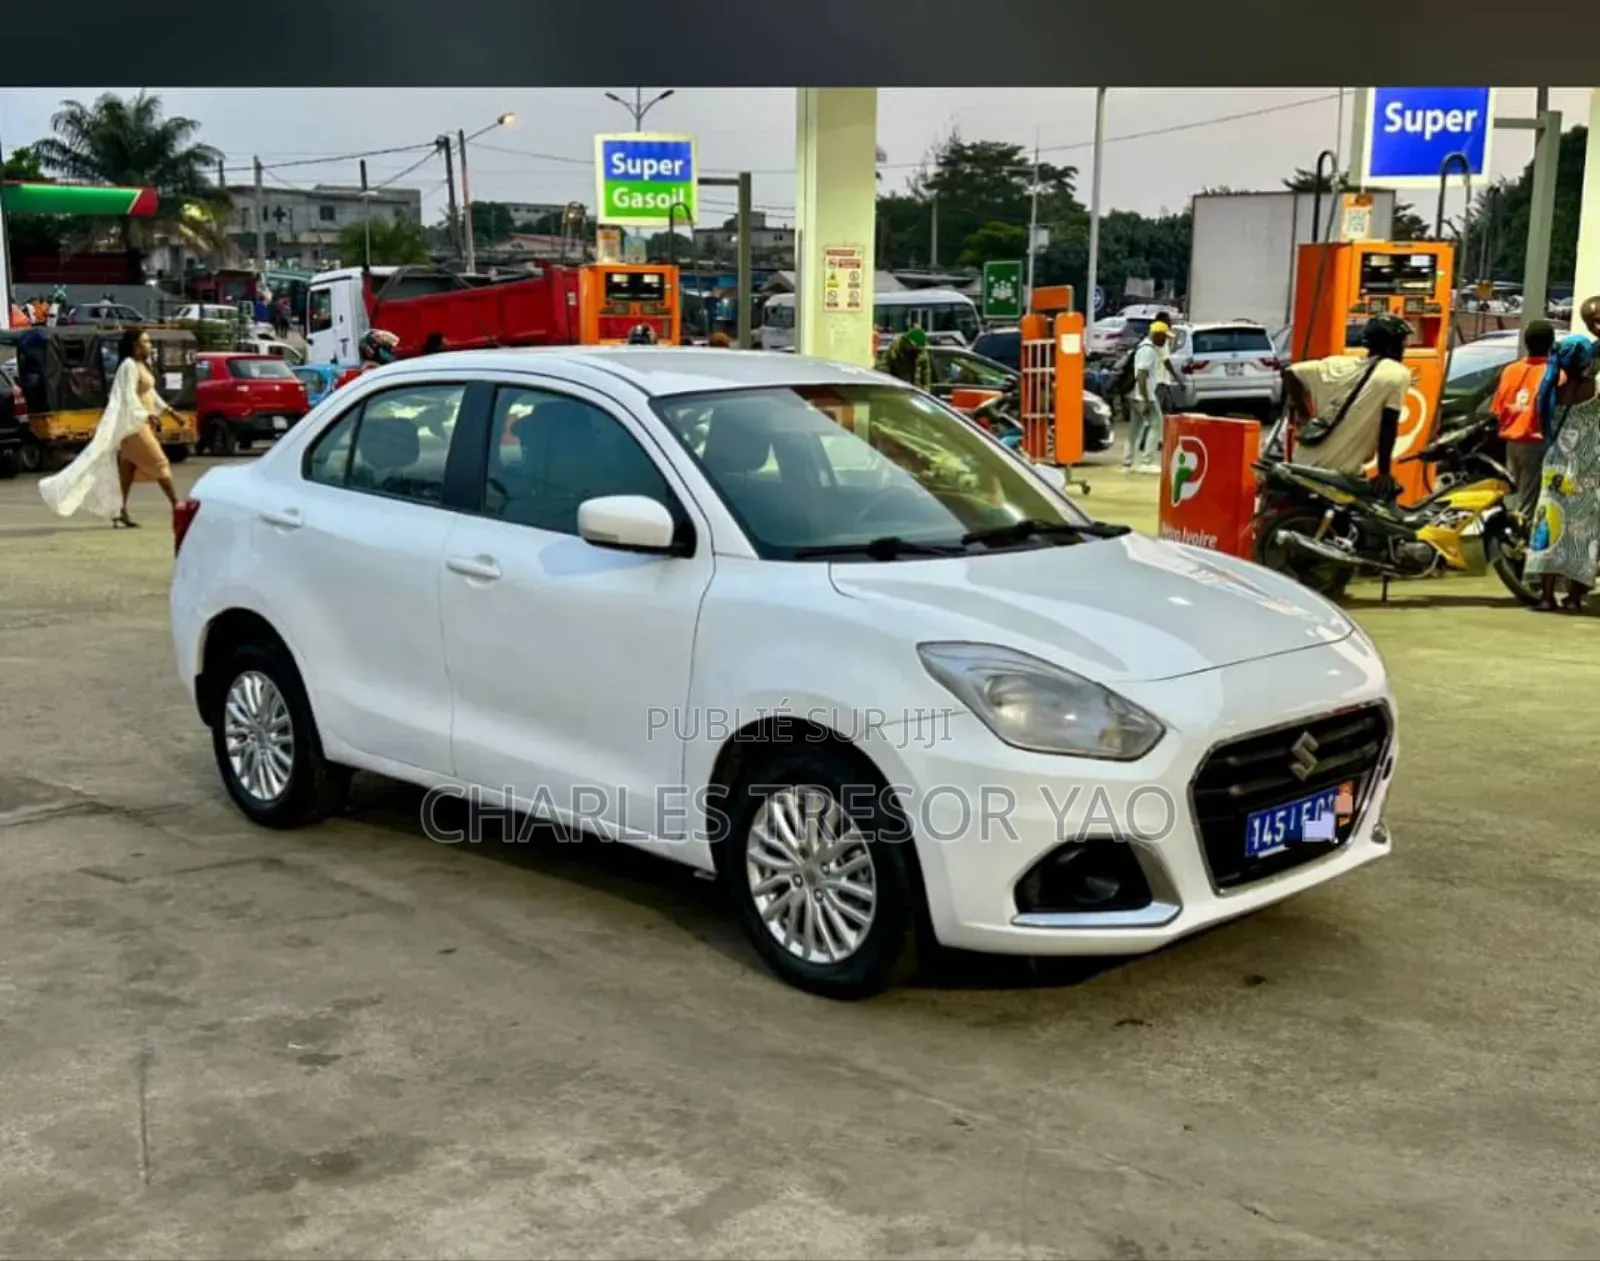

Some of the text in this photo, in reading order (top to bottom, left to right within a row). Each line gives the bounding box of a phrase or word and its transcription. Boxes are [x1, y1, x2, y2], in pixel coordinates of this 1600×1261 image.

[1384, 101, 1478, 141] Super
[611, 152, 684, 180] Super
[612, 187, 685, 209] Gasoil
